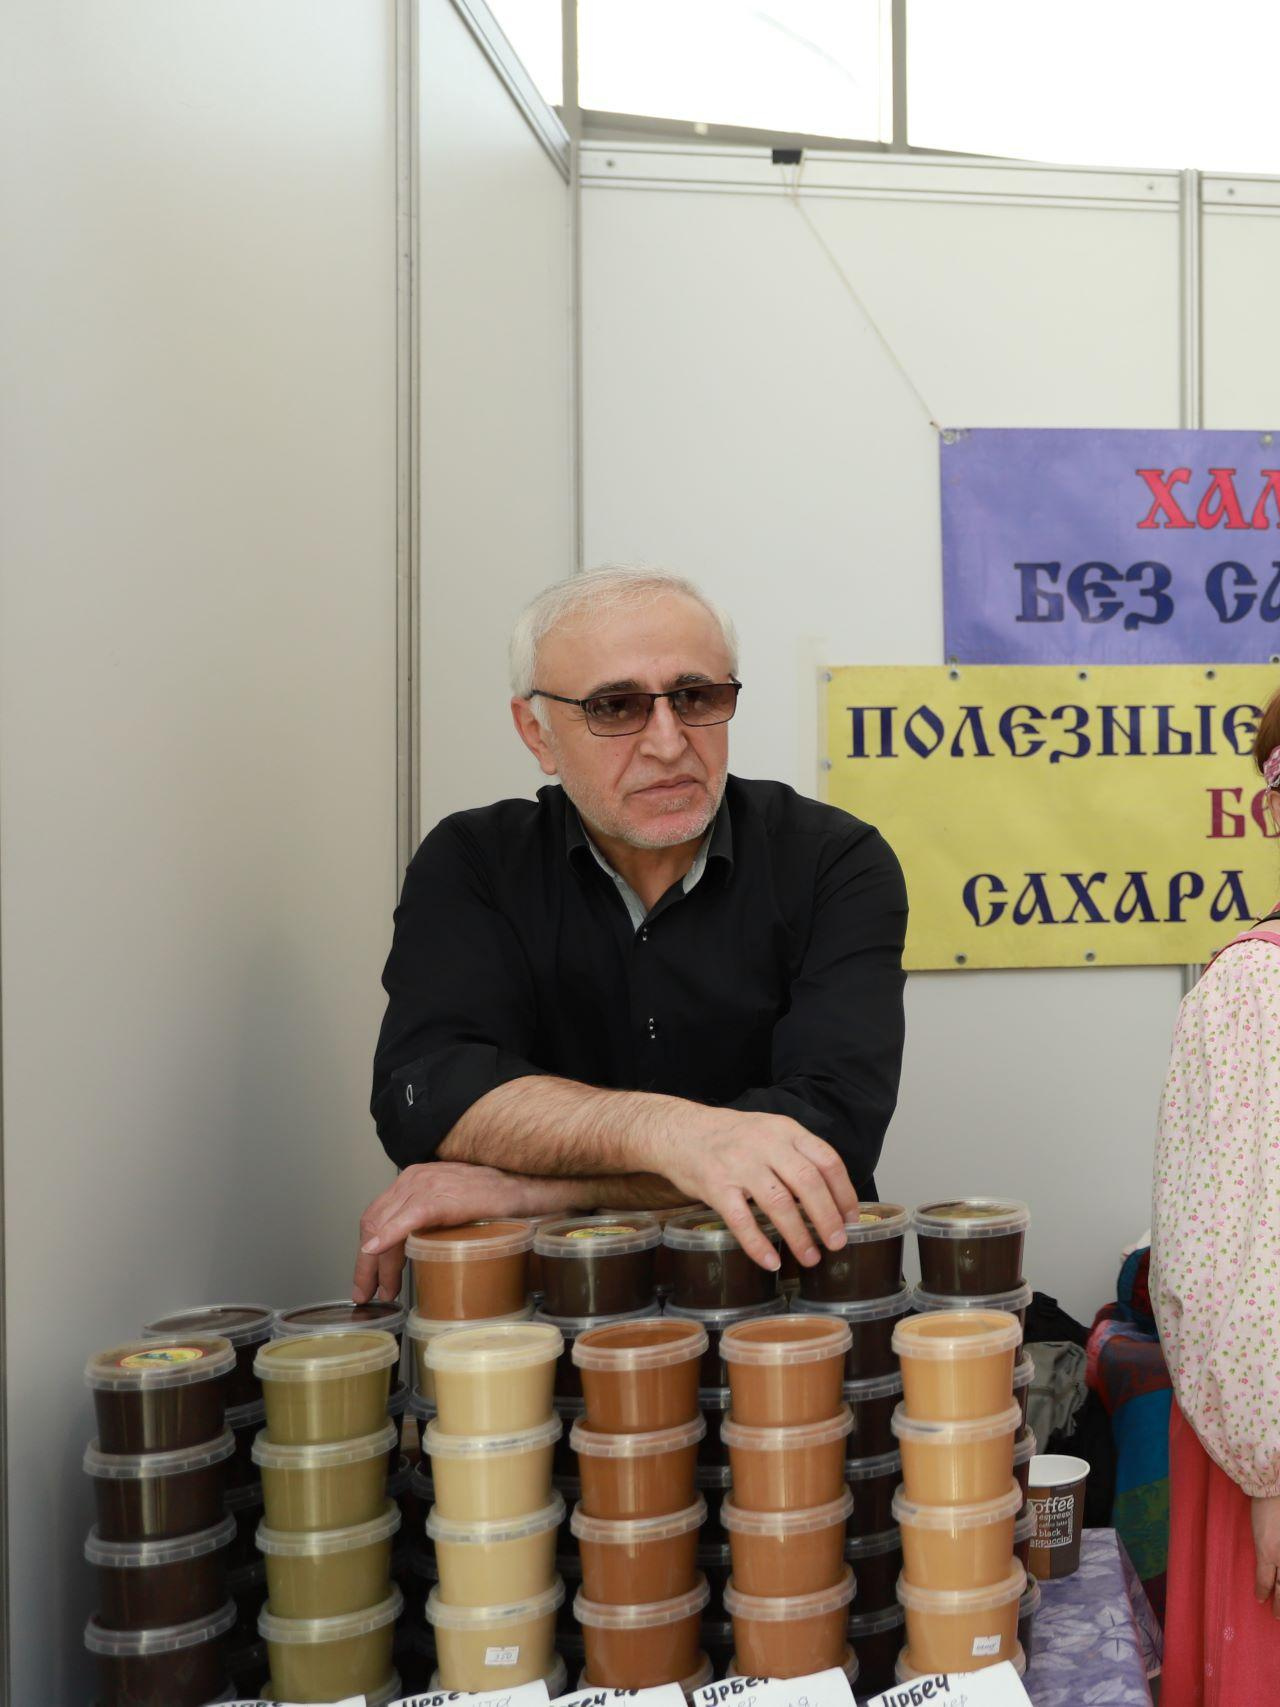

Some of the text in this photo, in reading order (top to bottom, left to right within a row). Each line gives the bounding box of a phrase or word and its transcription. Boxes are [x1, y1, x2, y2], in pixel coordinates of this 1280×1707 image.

[1014, 561, 1175, 631] БЕЗ
[845, 703, 1264, 764] ПОЛЕЗНЫЕ
[962, 870, 1256, 926] САХАРА
[1034, 1496, 1074, 1514] offee
[1039, 1528, 1062, 1537] black
